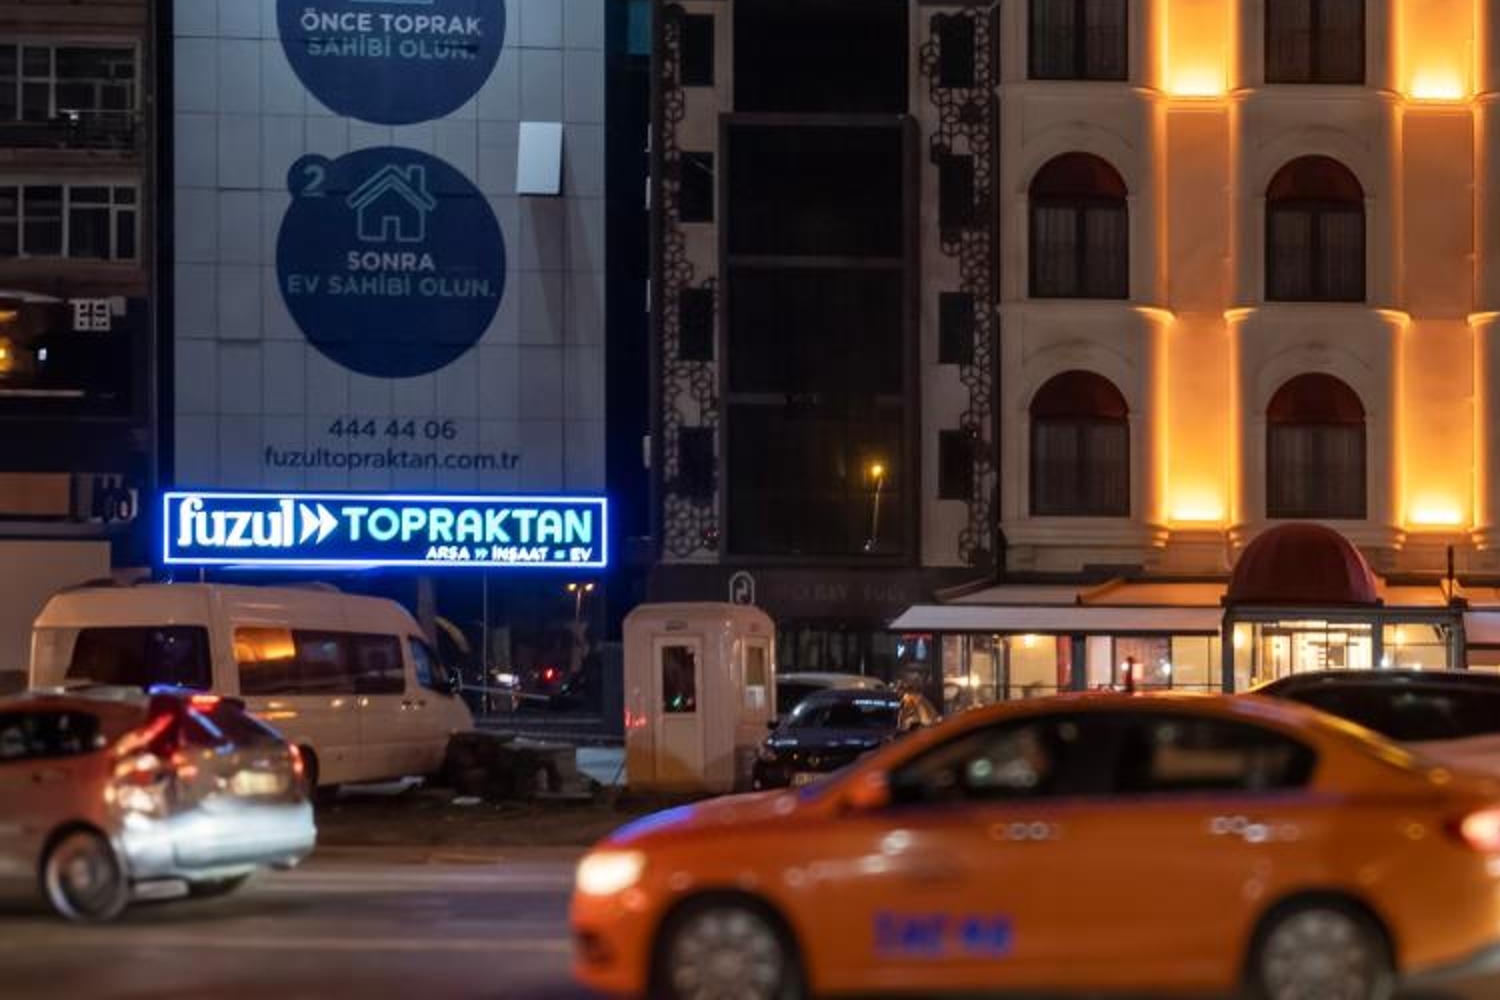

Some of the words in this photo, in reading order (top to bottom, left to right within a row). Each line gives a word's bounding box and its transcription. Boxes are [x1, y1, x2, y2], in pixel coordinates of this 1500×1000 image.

[302, 8, 372, 33] ÖNCE
[380, 13, 480, 35] TOPRAK
[307, 35, 391, 58] SAHİBİ
[303, 165, 326, 197] 2
[347, 251, 435, 271] SONRA
[287, 274, 320, 294] EV
[328, 274, 412, 296] SAHİBİ
[419, 277, 497, 298] OLUN.
[329, 420, 376, 440] 444
[384, 421, 417, 440] 44
[424, 422, 457, 441] 06
[264, 447, 519, 473] fuzultopraktan.com.tr
[177, 496, 294, 548] fuzul
[342, 507, 592, 544] TOPRAKTAN
[426, 546, 471, 561] ARSA
[570, 547, 592, 561] EV
